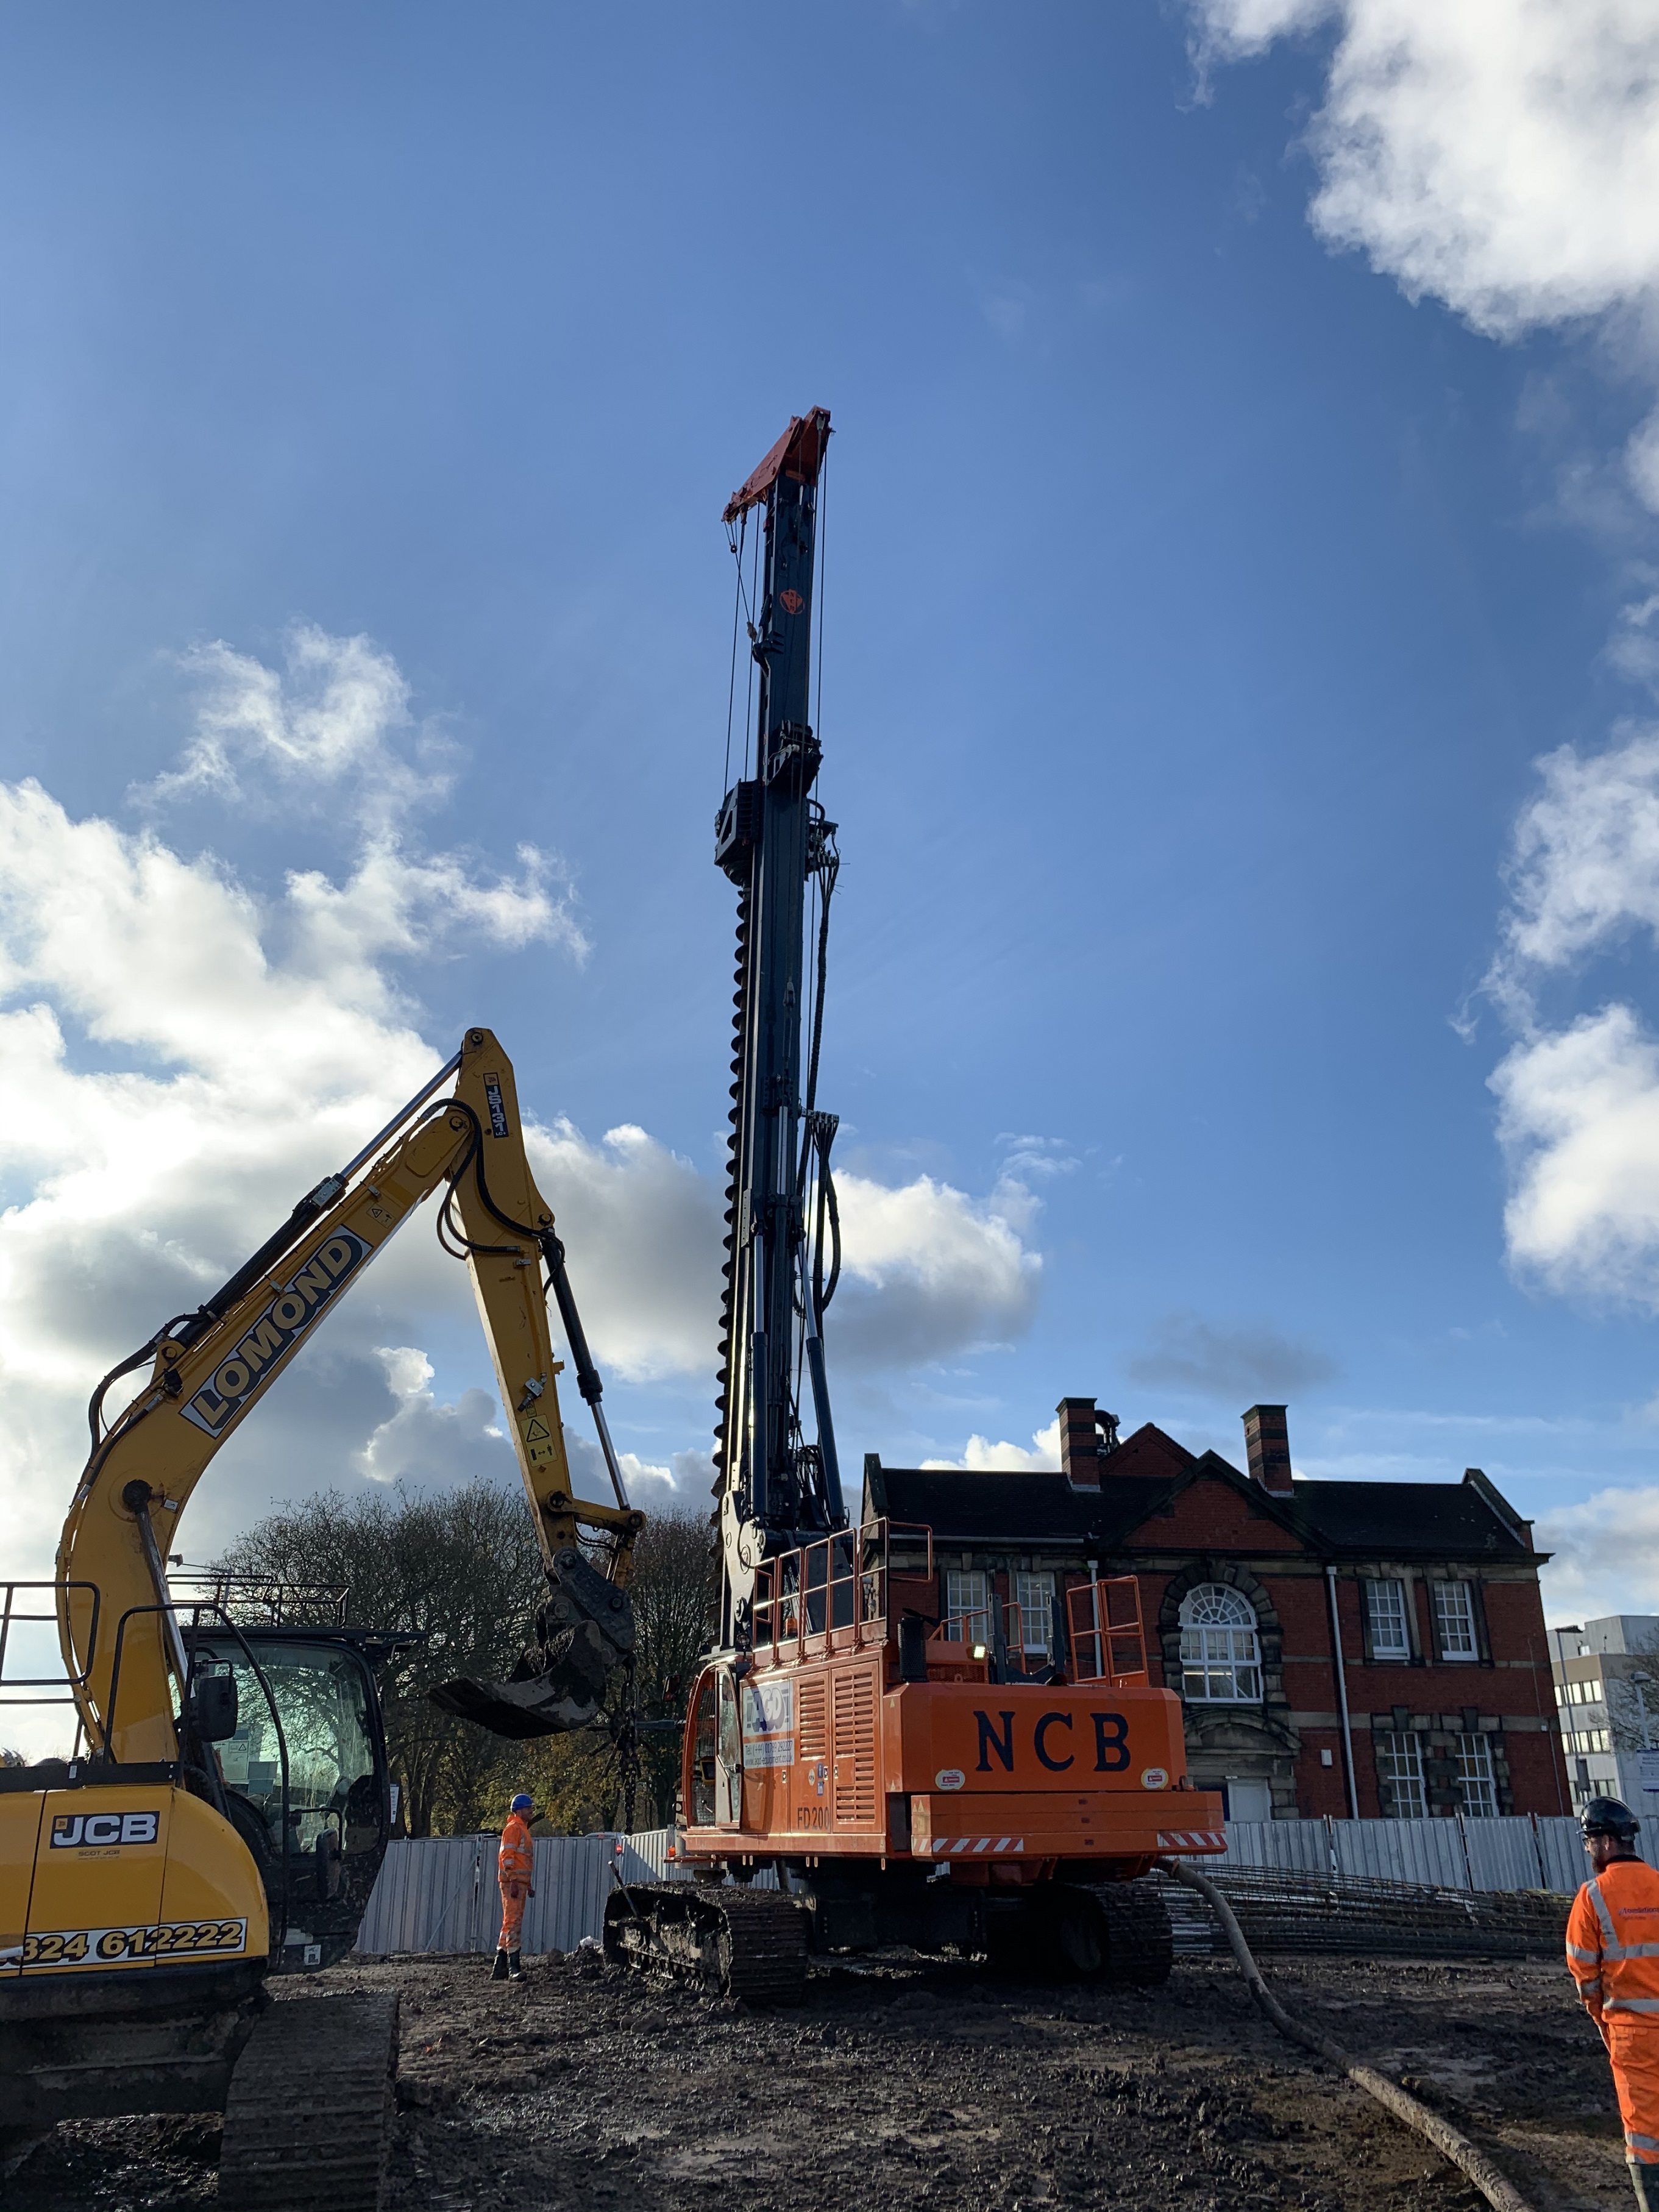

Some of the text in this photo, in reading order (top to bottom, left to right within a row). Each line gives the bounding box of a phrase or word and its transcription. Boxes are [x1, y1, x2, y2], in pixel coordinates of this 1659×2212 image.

[488, 1086, 505, 1132] JS131
[191, 1237, 358, 1428] LOMOND
[751, 1687, 786, 1732] AGD
[973, 1710, 1131, 1772] NCB
[54, 1814, 156, 1846] JCB
[99, 1921, 244, 1959] 612222
